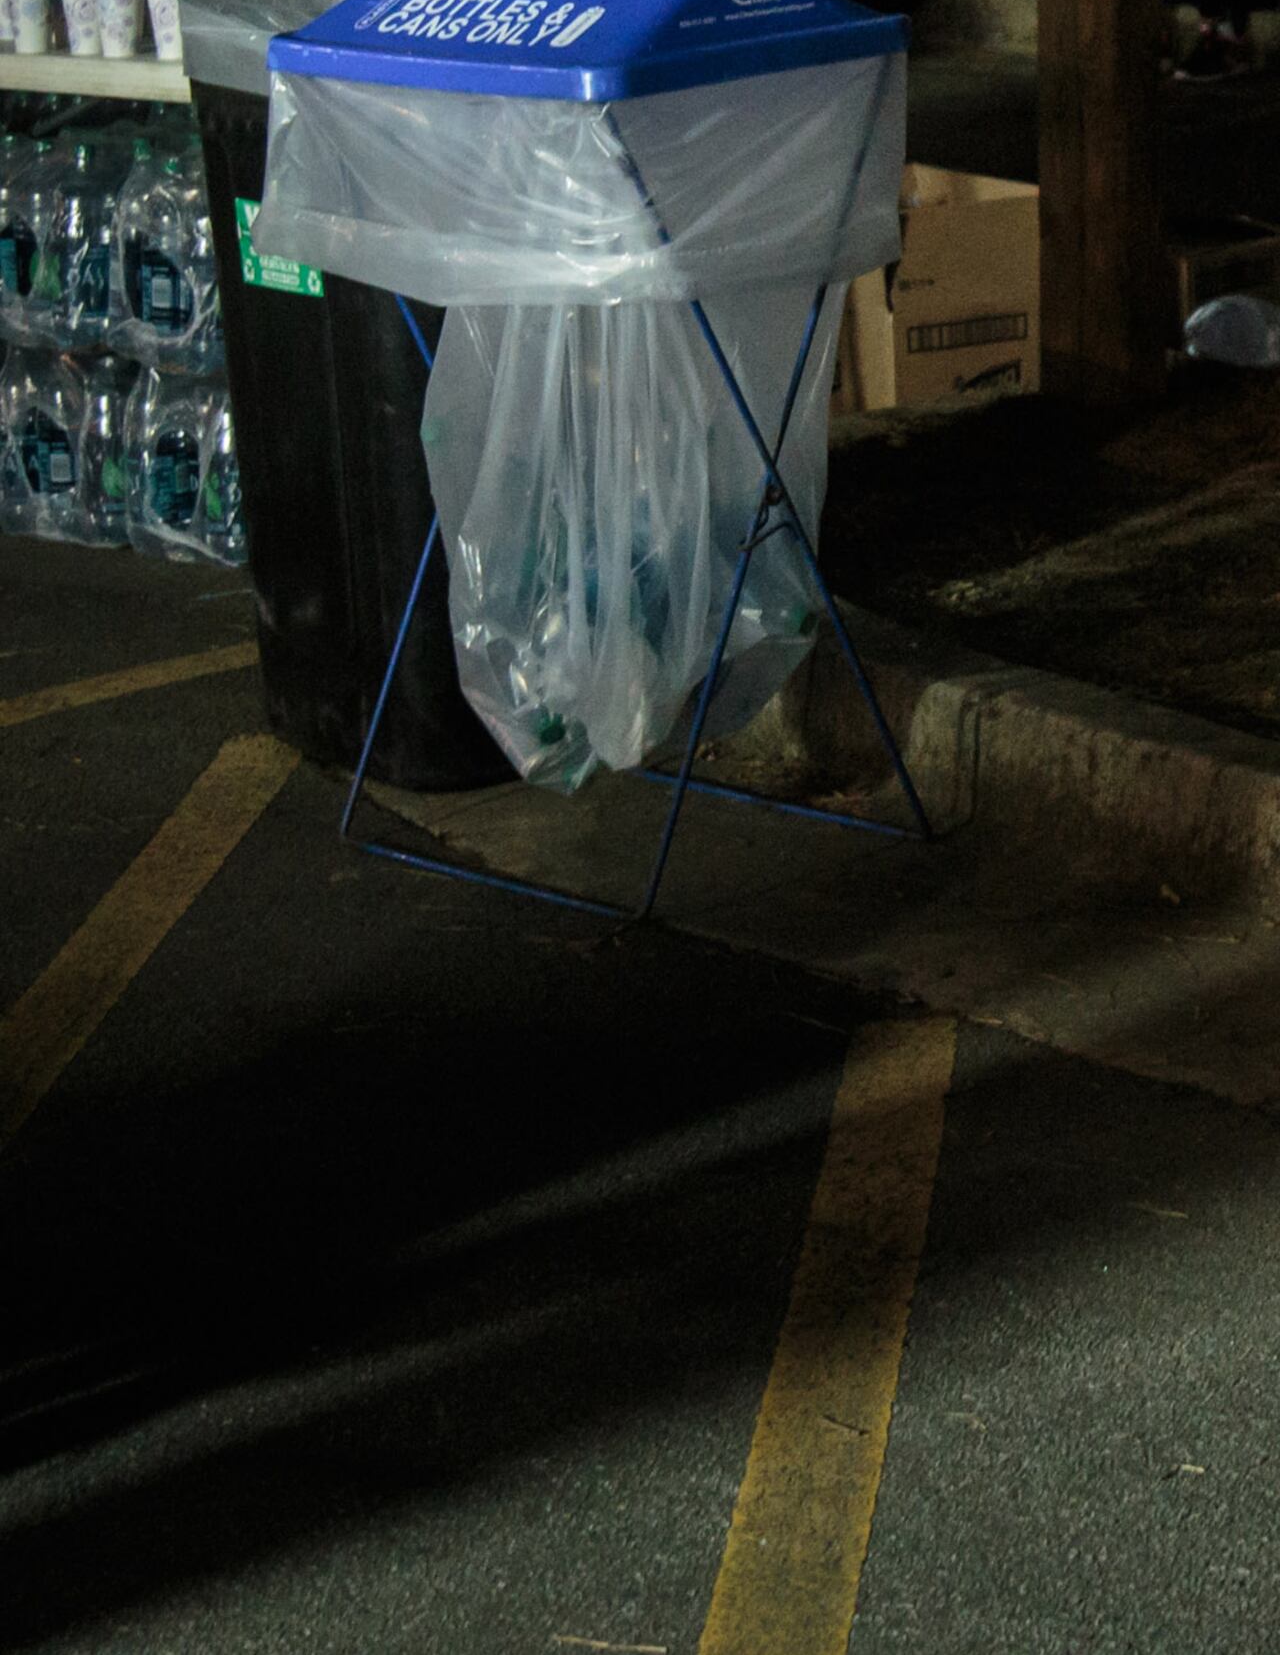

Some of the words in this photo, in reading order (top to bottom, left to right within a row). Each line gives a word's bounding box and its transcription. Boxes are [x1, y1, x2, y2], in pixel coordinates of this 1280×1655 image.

[544, 2, 575, 25] &
[378, 11, 469, 40] CANS
[465, 20, 561, 47] ONLY
